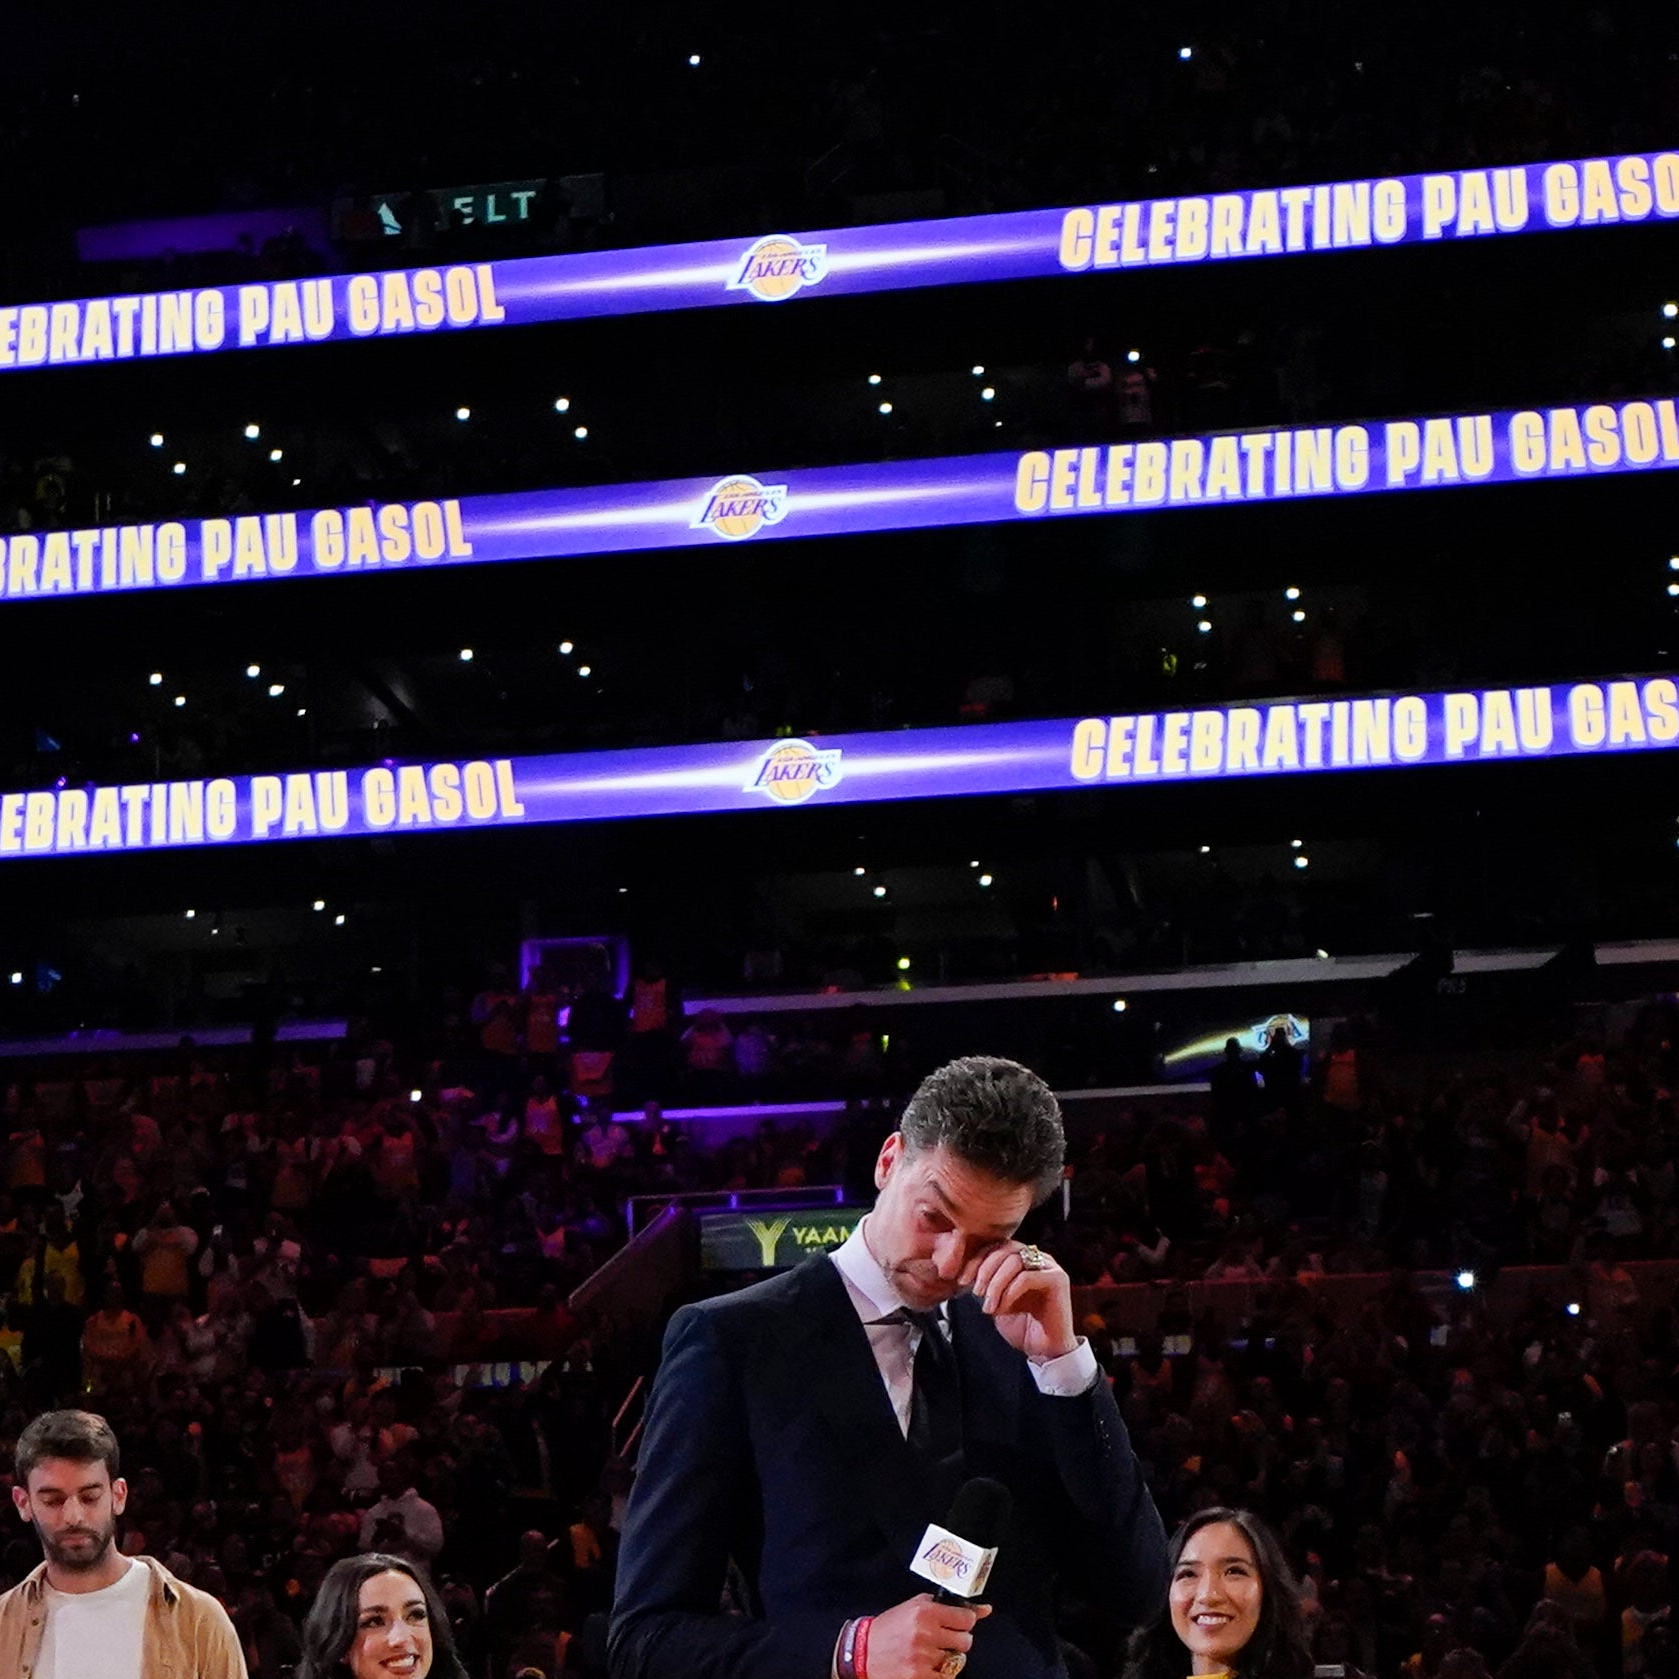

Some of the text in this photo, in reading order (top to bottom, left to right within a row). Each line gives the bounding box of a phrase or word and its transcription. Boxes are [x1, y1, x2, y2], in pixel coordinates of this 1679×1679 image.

[453, 190, 537, 225] ELT
[1058, 179, 1407, 269] CELEBRATING
[1422, 167, 1530, 239] PAU
[238, 279, 335, 346] PAU
[347, 264, 506, 334] GASOL
[737, 256, 819, 284] LAKERS
[1013, 425, 1370, 513] CELEBRATING
[1385, 415, 1495, 486] PAU
[201, 513, 299, 581] PAU
[311, 499, 474, 569] GASOL
[700, 495, 778, 523] LAKERS
[754, 759, 832, 786] LAKERS
[1068, 696, 1428, 781] CELEBRATING
[1443, 687, 1554, 760] PAU
[250, 771, 350, 839] PAU
[362, 759, 526, 830] GASOL
